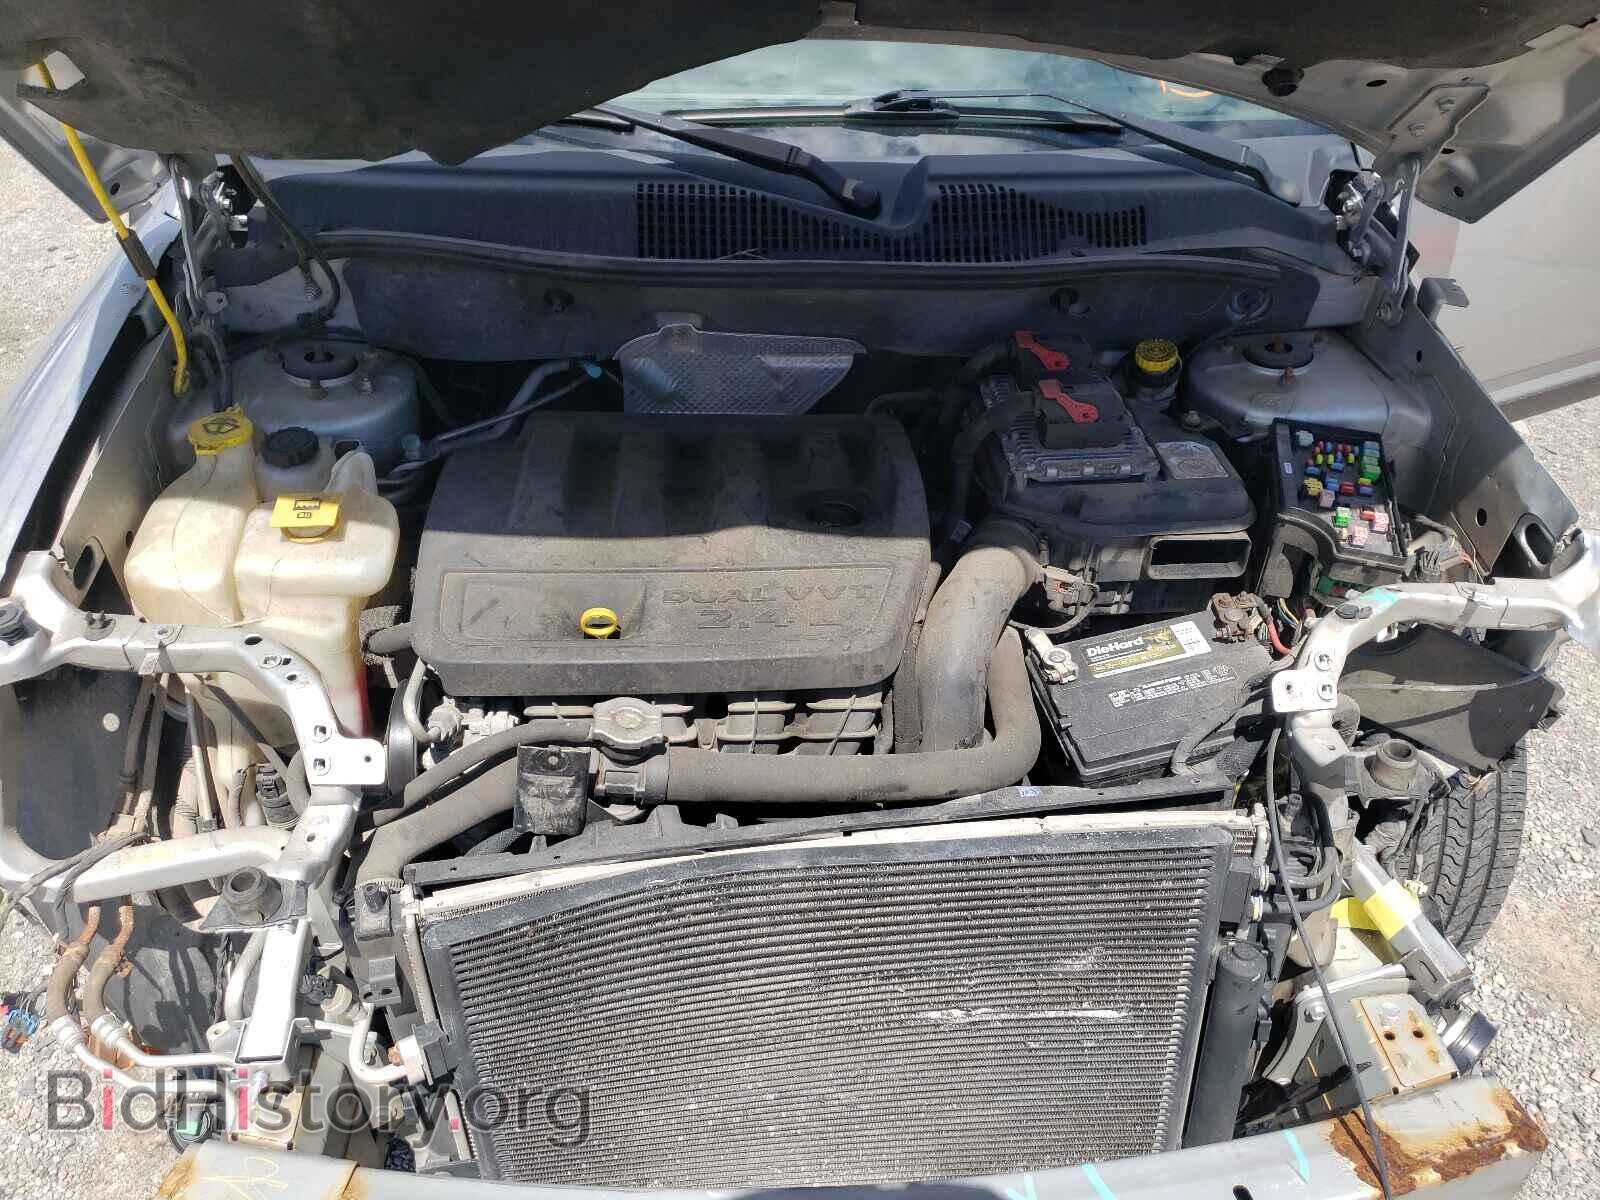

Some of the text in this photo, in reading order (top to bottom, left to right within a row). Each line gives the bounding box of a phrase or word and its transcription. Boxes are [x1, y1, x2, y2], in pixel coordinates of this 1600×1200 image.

[662, 584, 873, 604] DUAL VVT
[1086, 636, 1144, 657] DieHard
